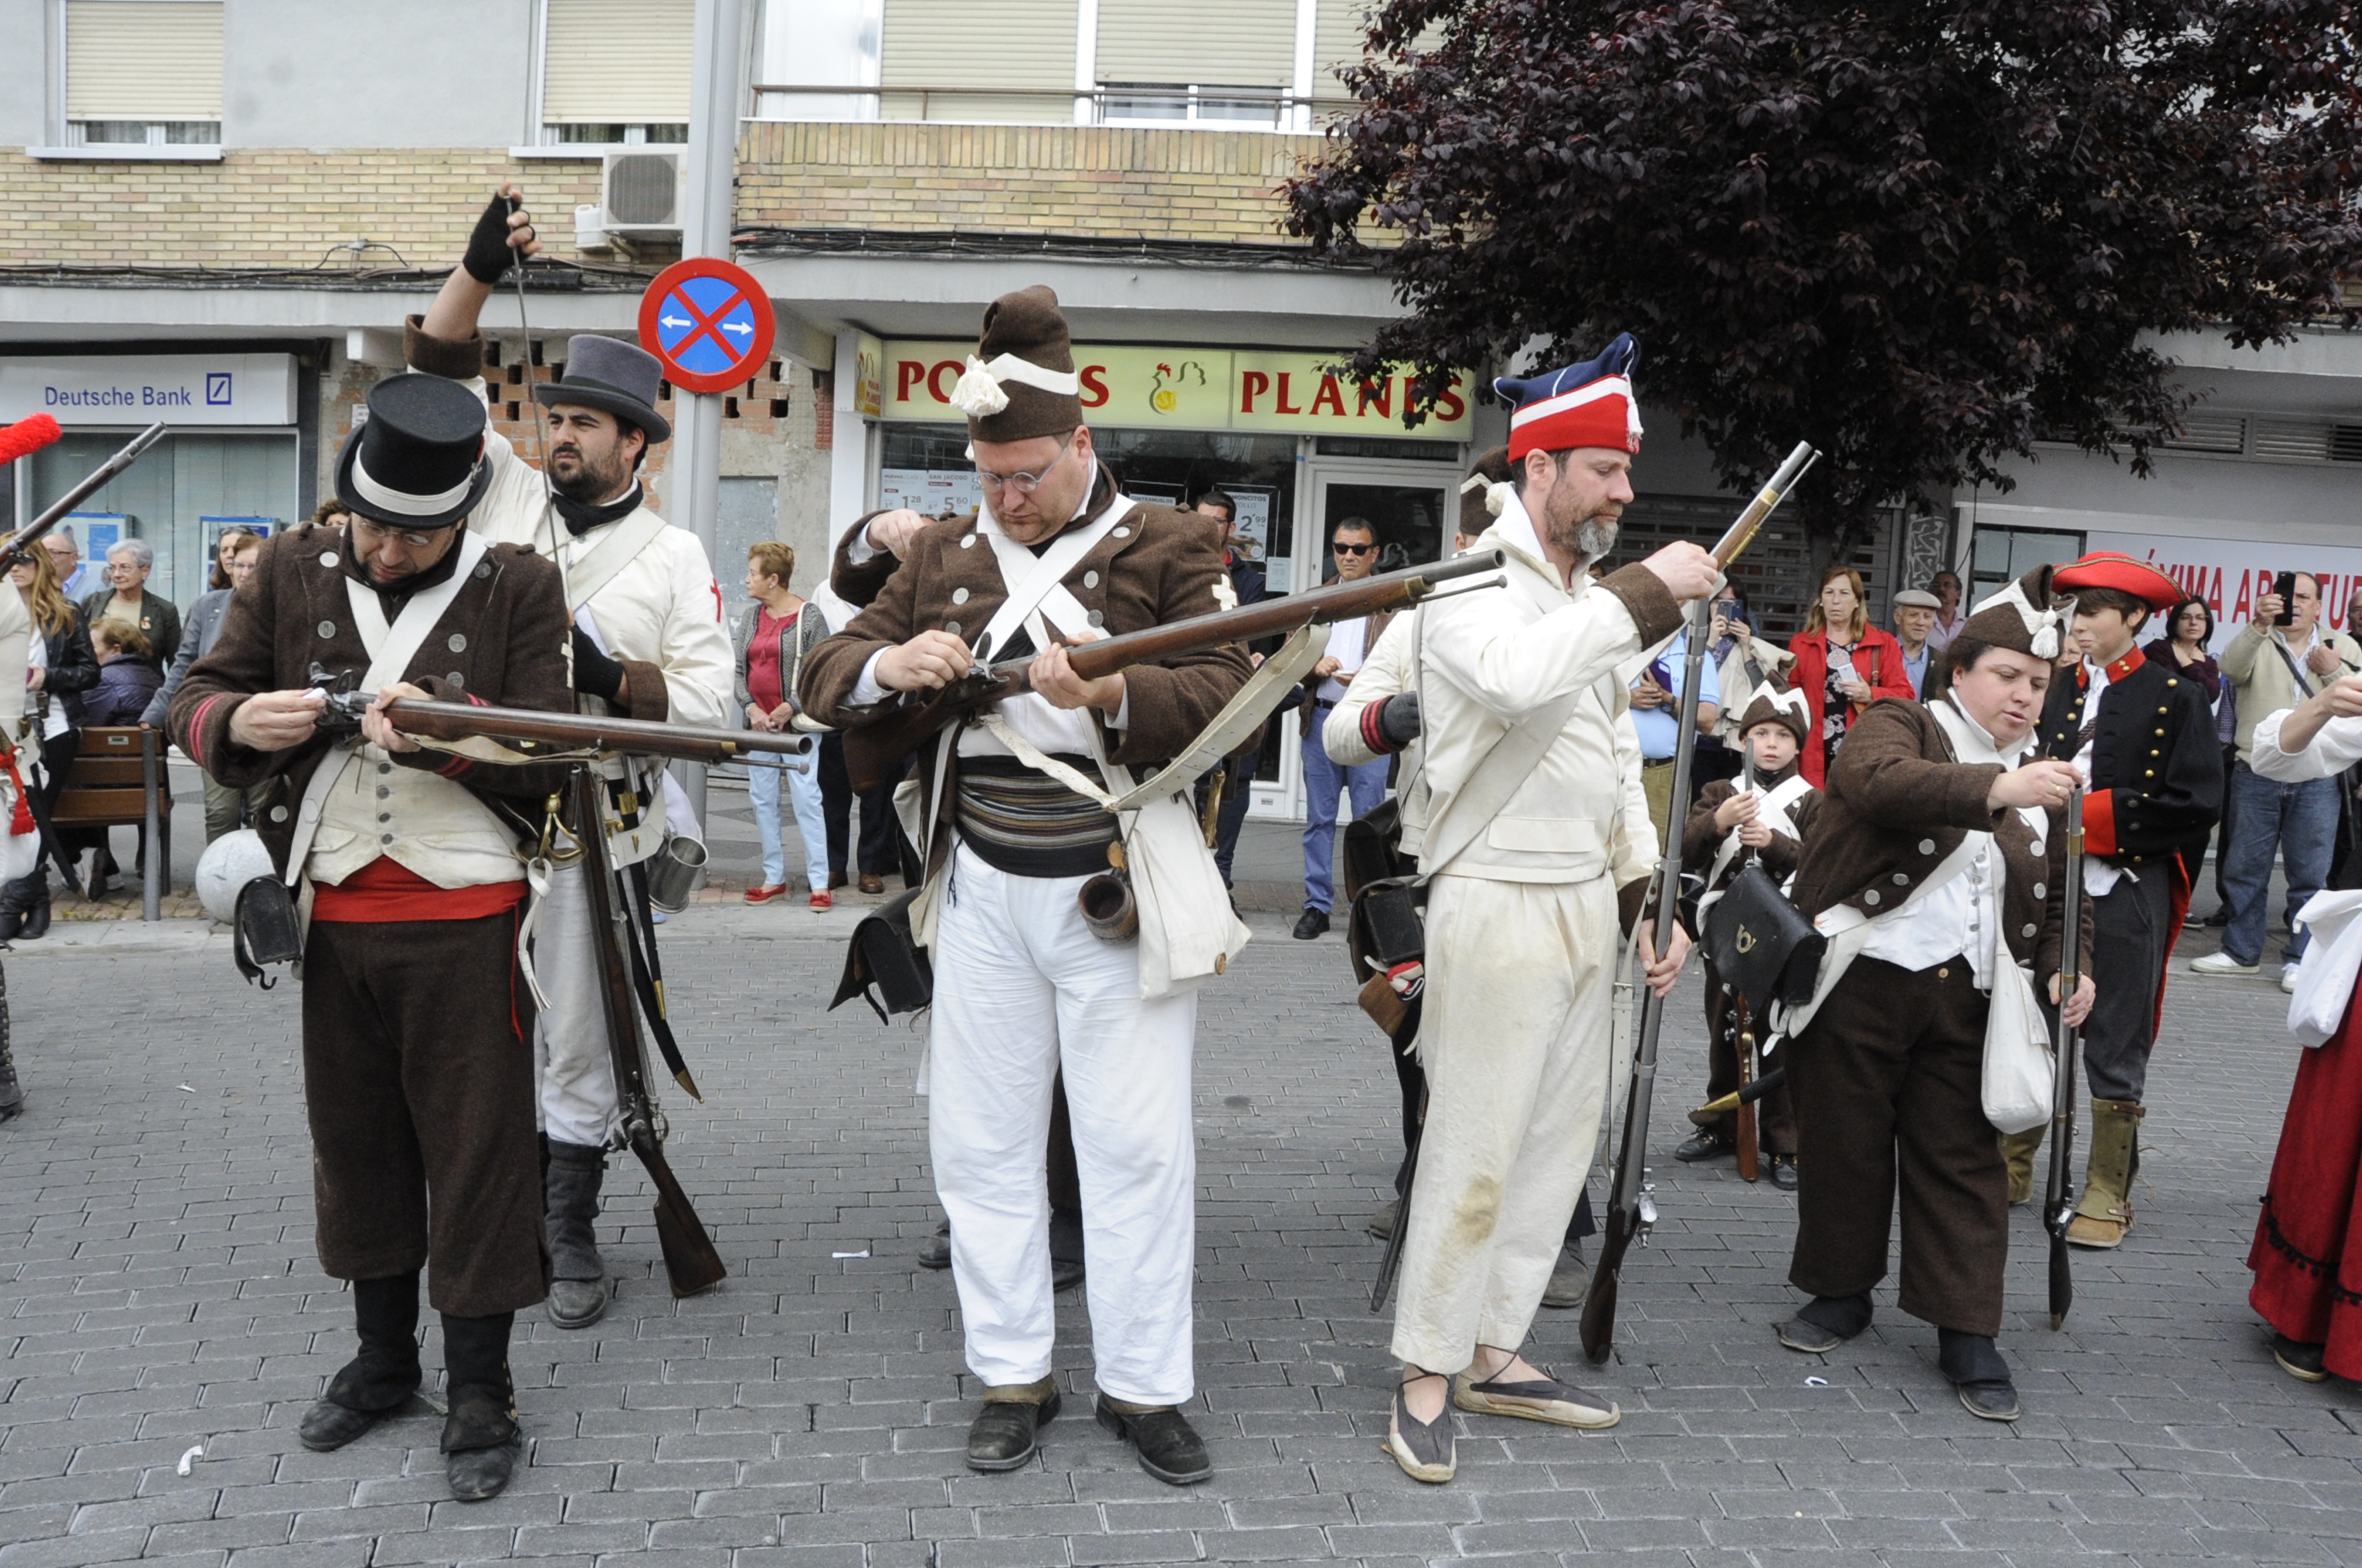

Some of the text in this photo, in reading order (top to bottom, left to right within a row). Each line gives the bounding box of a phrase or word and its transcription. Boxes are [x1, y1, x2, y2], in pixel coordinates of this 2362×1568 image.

[45, 386, 192, 406] Deutsche Bank
[896, 360, 1110, 407] POS
